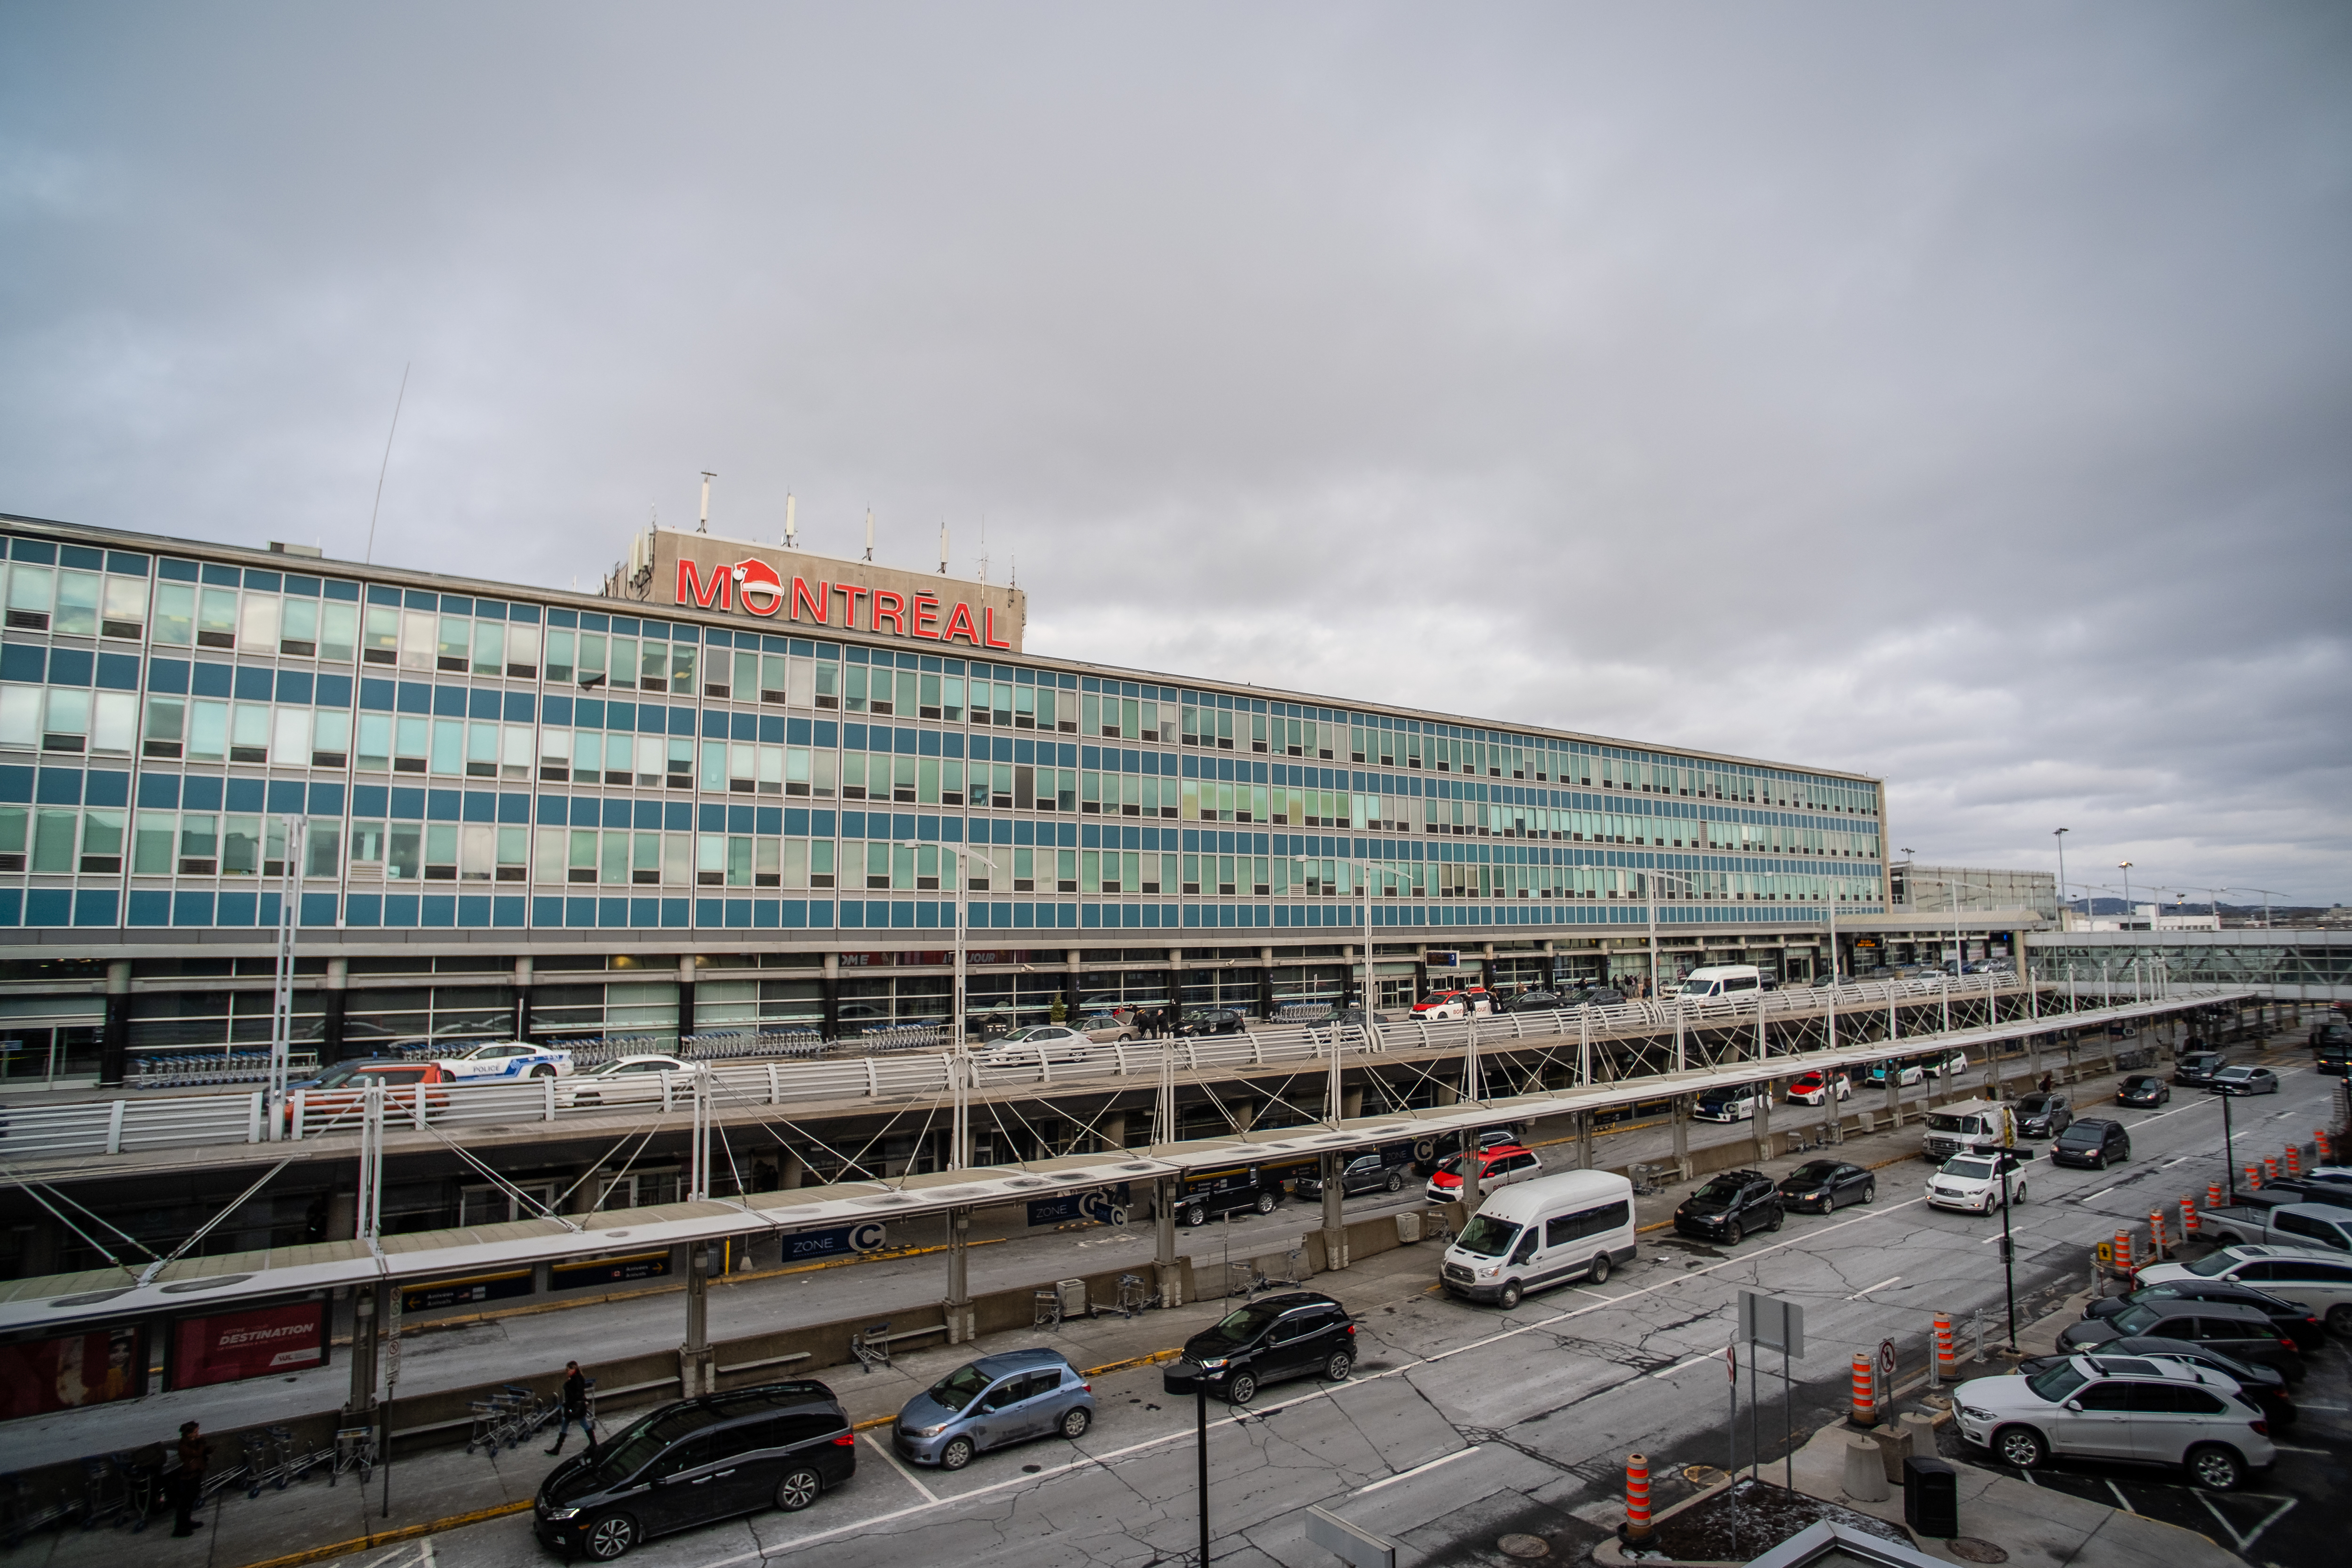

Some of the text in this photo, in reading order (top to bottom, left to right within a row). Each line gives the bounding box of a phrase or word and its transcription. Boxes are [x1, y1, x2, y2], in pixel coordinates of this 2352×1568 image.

[675, 557, 1011, 649] MONTRÉAL
[1726, 1104, 1736, 1114] C
[1386, 1141, 1431, 1161] ZONE C
[1036, 1204, 1067, 1218] ZONE
[1096, 1208, 1124, 1226] ZONE C
[793, 1224, 882, 1253] ZONE C
[219, 1323, 314, 1345] DESTINATION
